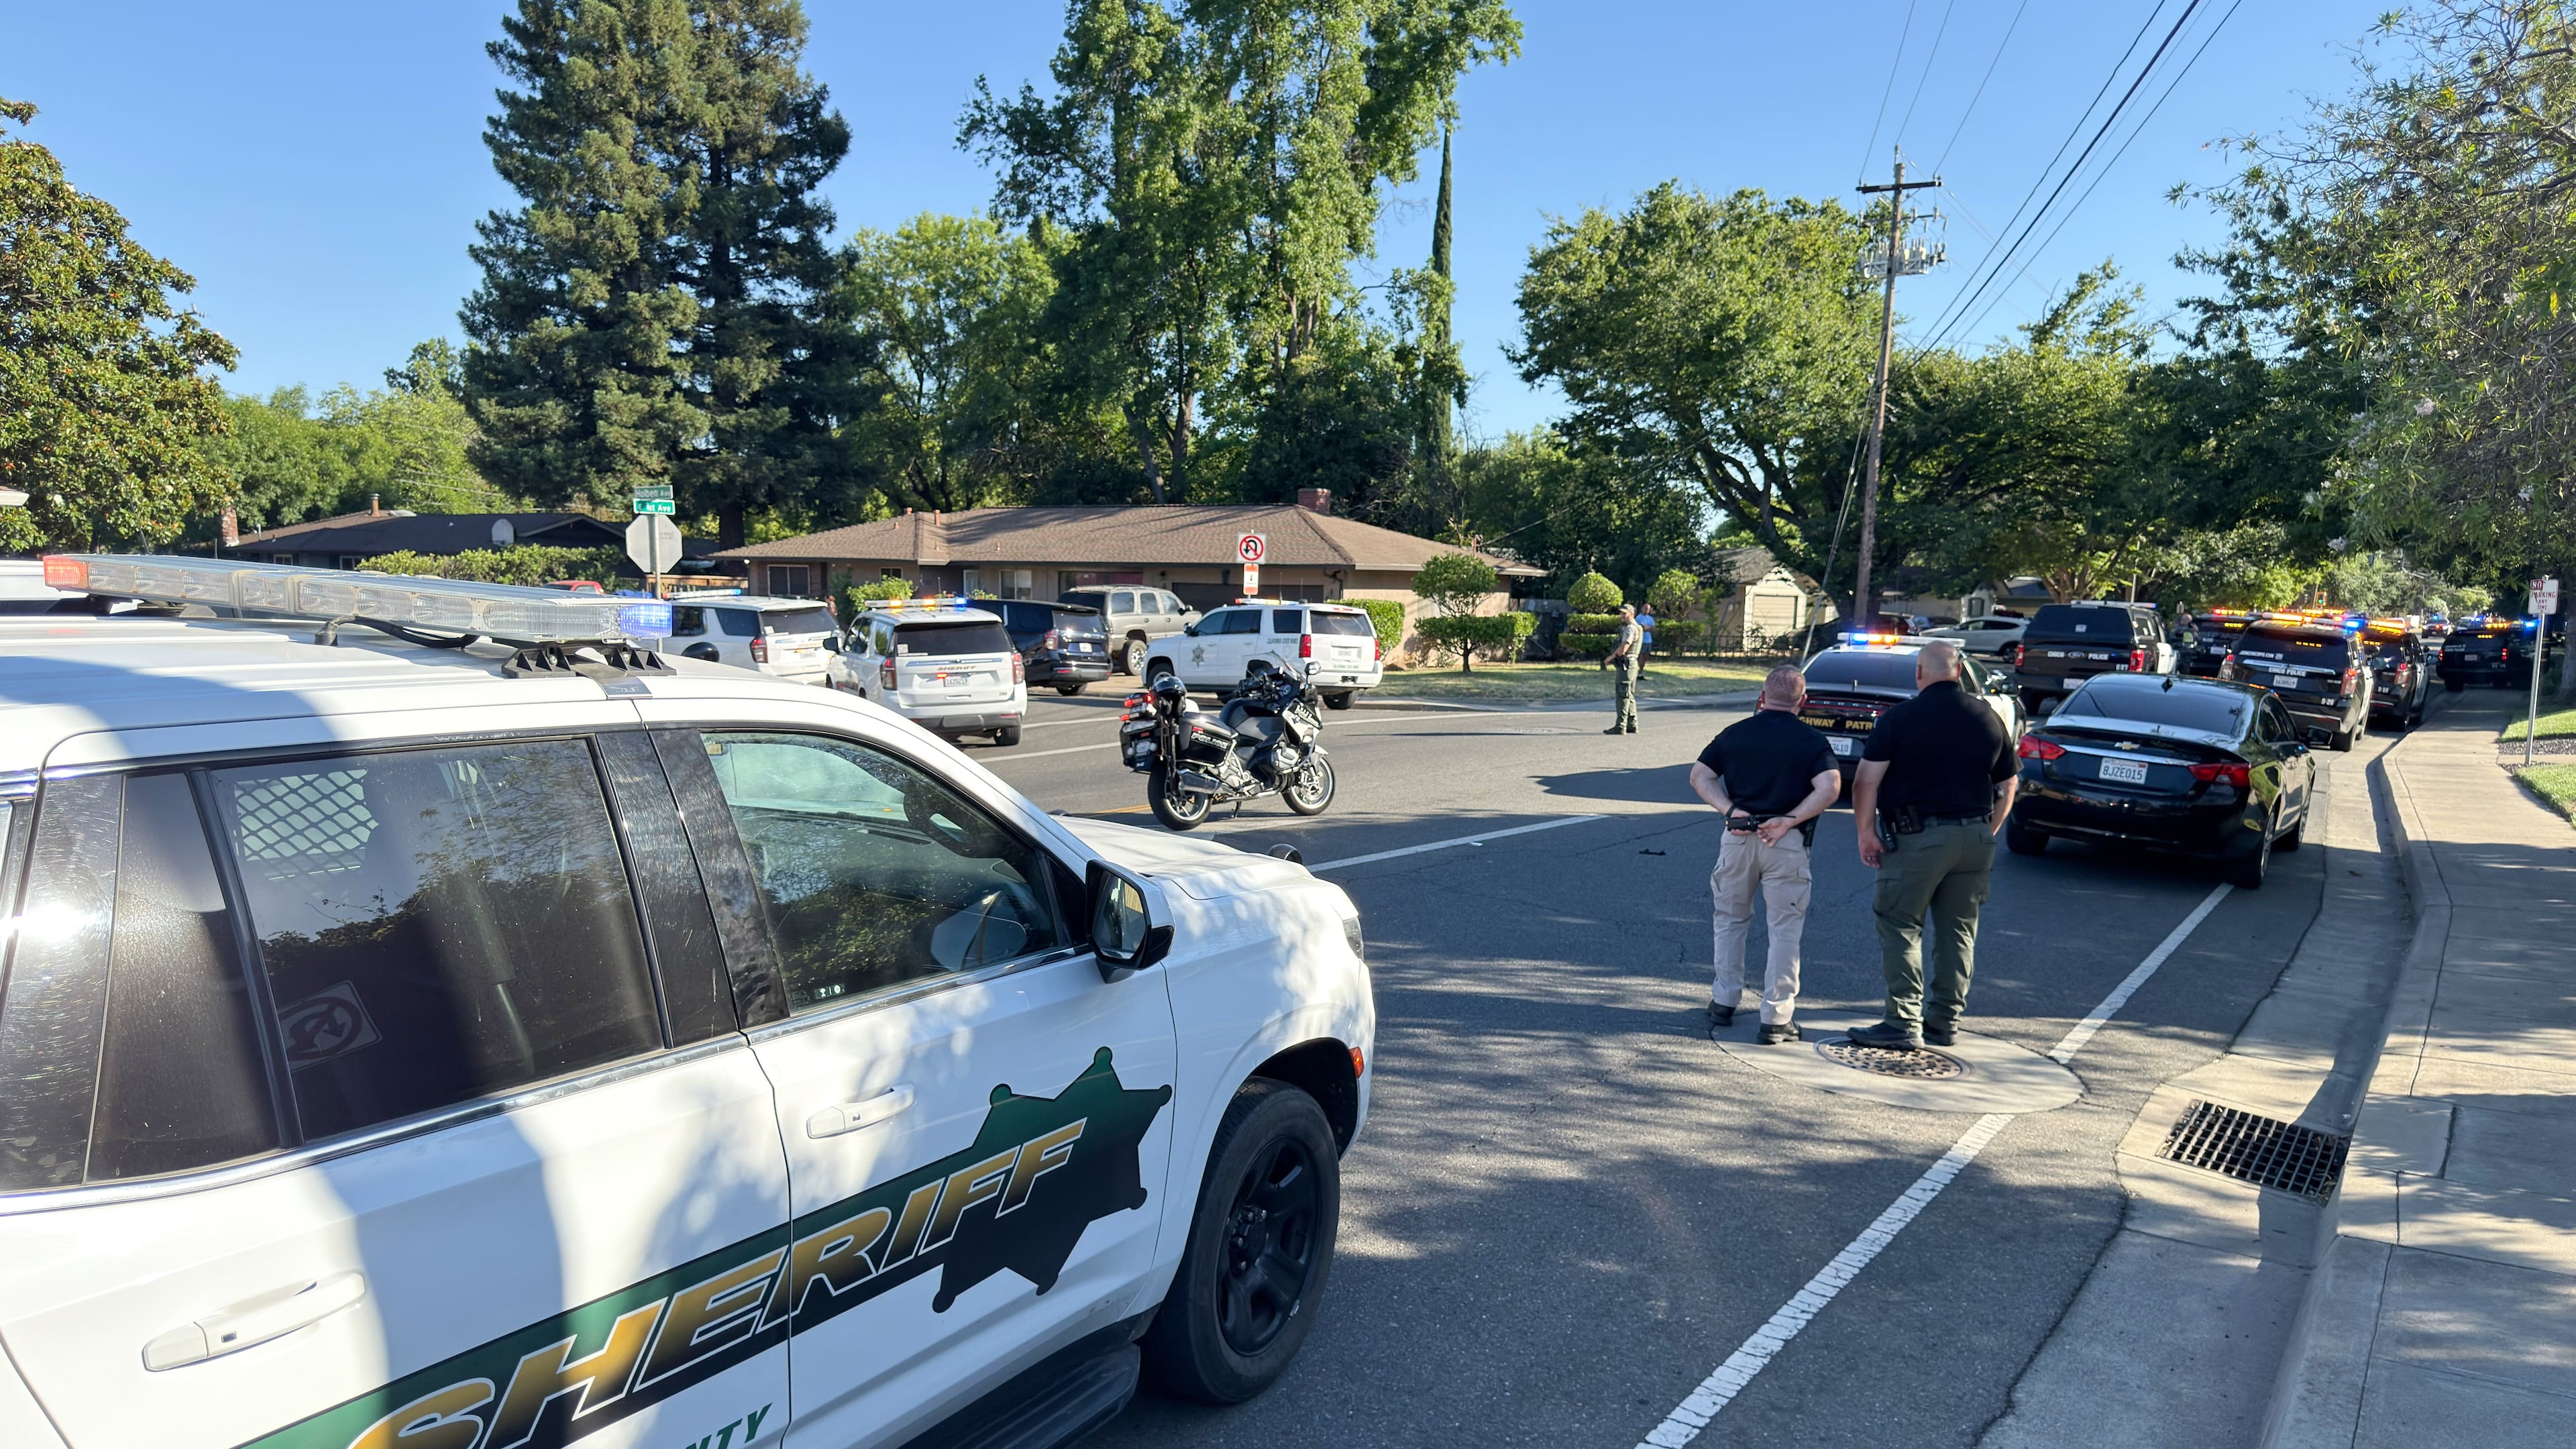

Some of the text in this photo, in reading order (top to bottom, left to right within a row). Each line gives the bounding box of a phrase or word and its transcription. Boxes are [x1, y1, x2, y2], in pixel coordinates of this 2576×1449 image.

[658, 504, 671, 512] Ave
[2532, 581, 2542, 590] NO
[2268, 667, 2306, 677] CHICO POLICE
[1191, 733, 1229, 749] POLICE
[2102, 765, 2143, 780] 8JZE015
[347, 1116, 1087, 1449] SHERIFF
